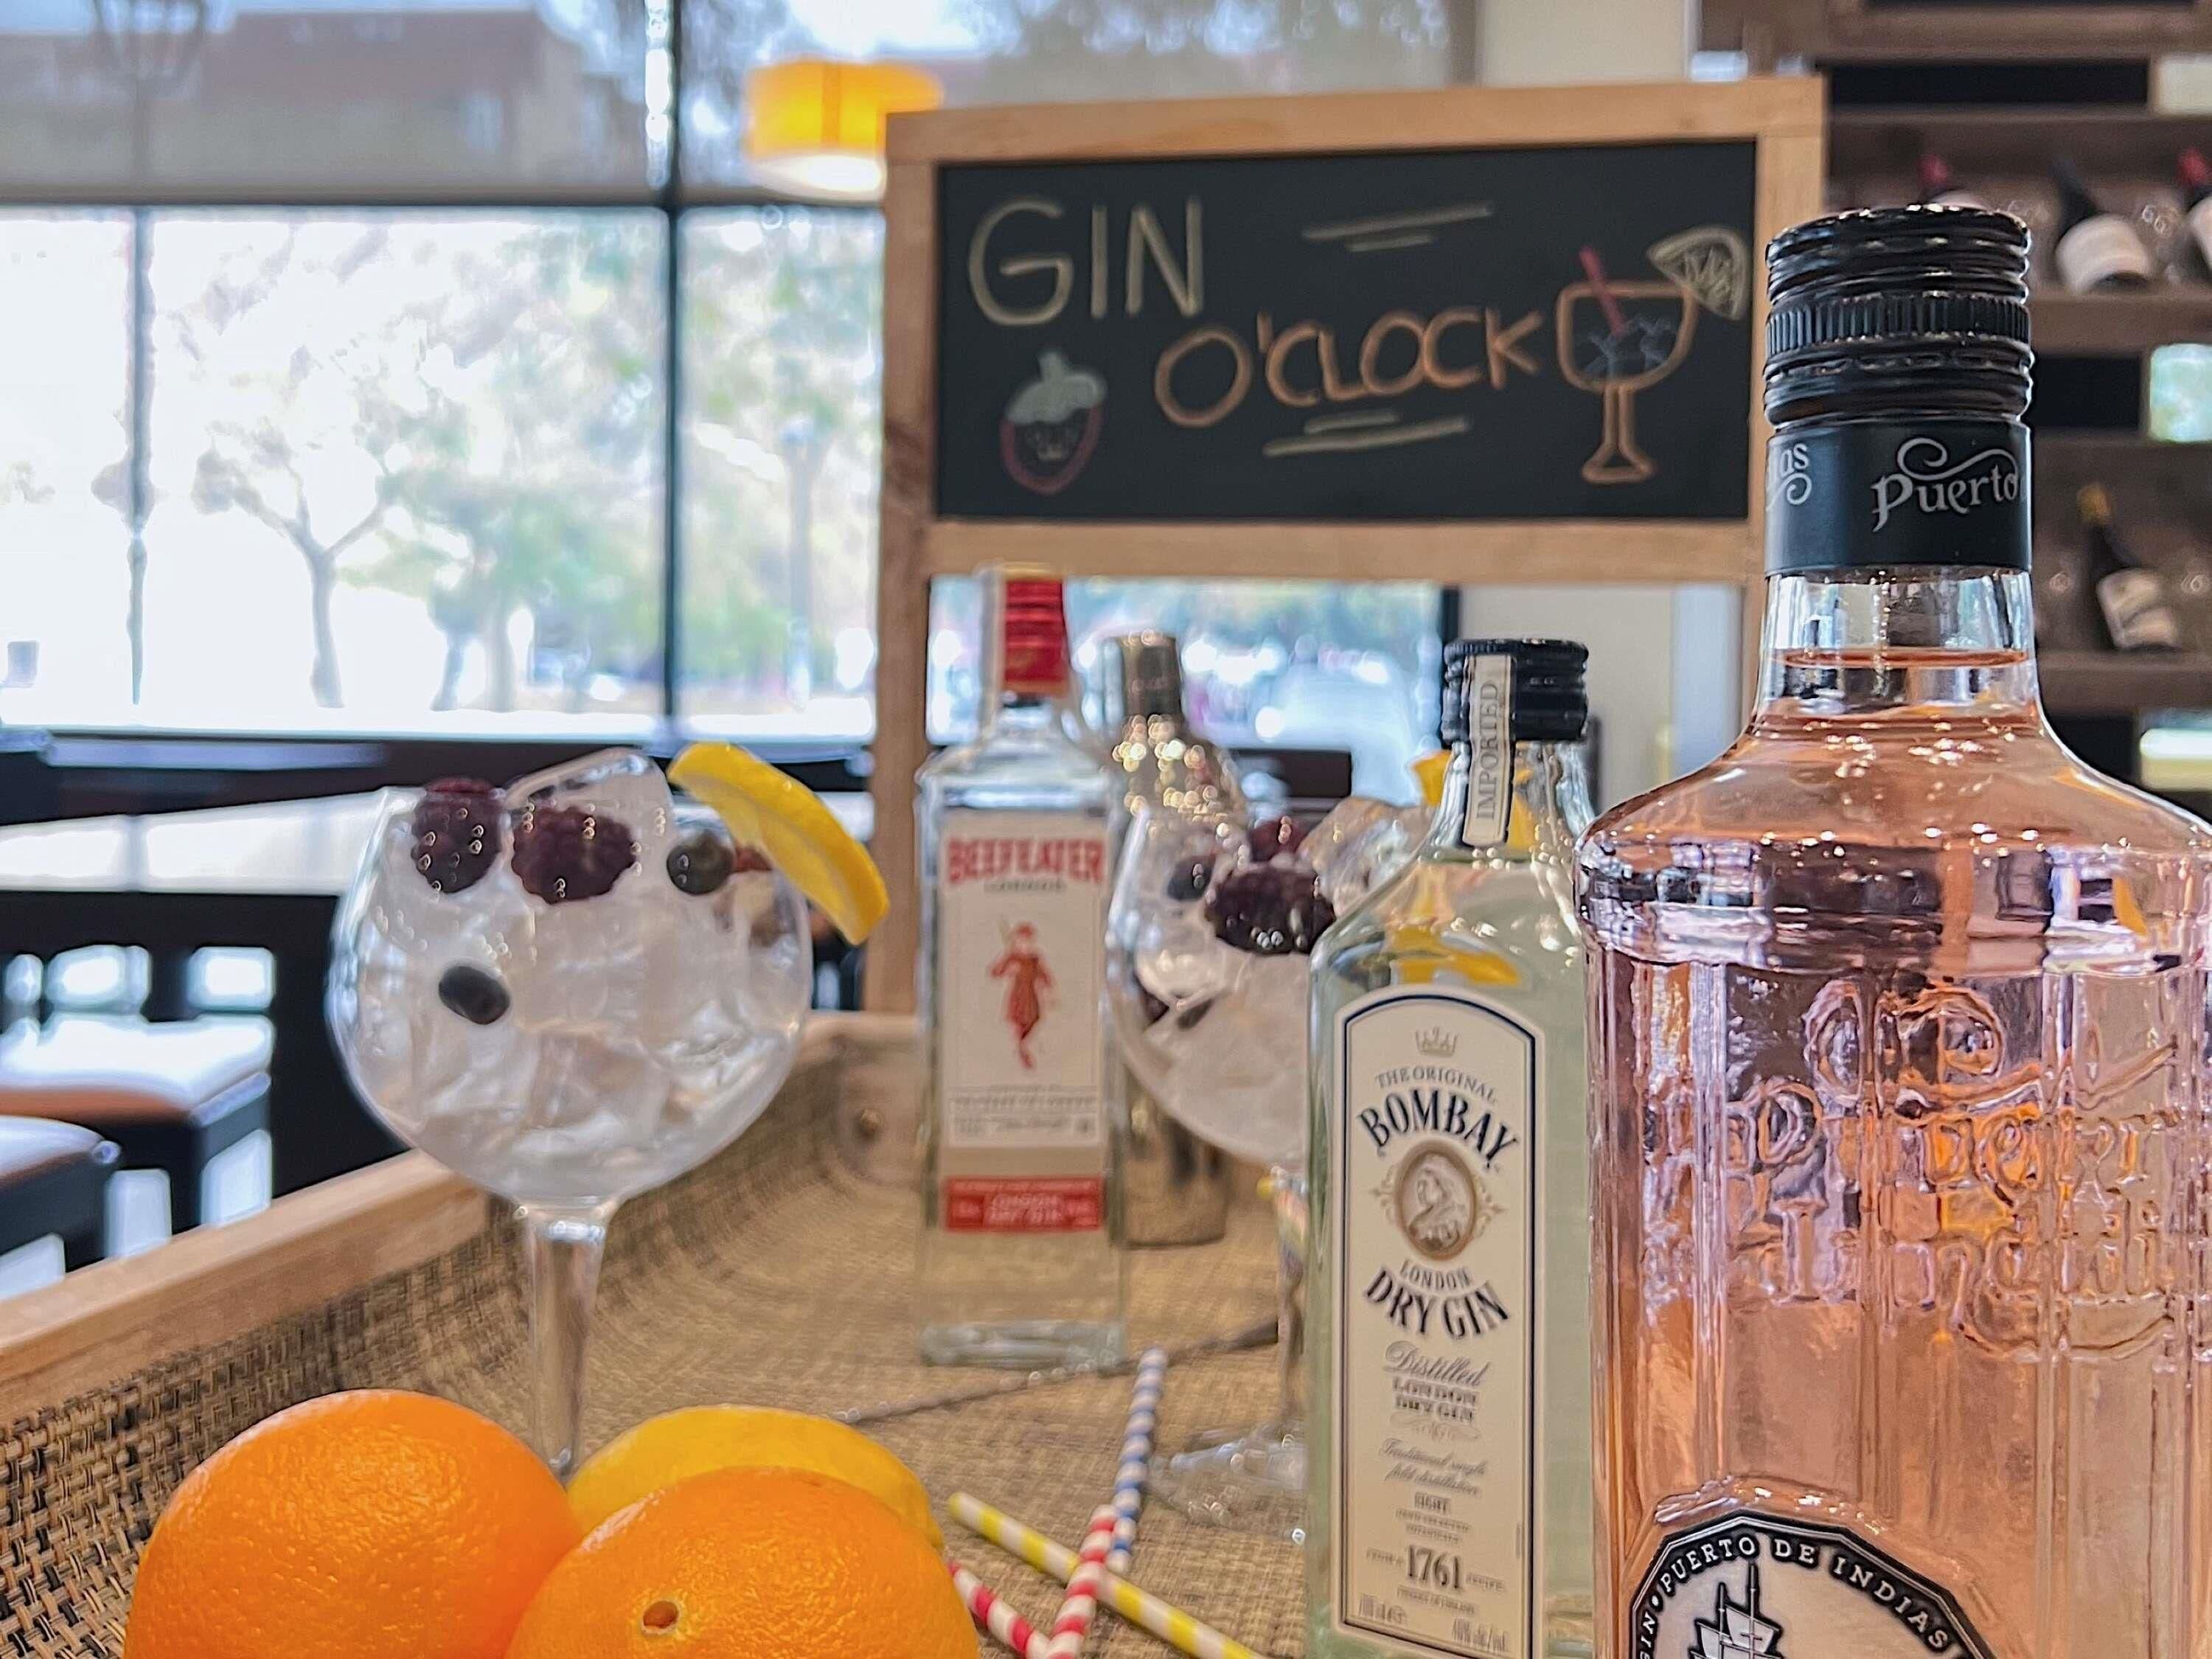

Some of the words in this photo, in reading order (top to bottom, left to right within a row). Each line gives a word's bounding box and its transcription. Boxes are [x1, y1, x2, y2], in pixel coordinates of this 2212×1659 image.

[968, 197, 1206, 326] GIN
[1871, 438, 2020, 532] Puerto
[1475, 681, 1500, 820] IMPORTED
[949, 837, 1105, 883] BEEFEATER
[1375, 1068, 1410, 1089] THE
[1412, 1065, 1497, 1104] ORIGINAL
[1359, 1088, 1518, 1162] BOMBAY
[1364, 1265, 1438, 1335] DRY
[1443, 1281, 1509, 1340] GIN
[1400, 1259, 1471, 1290] LONDON
[1382, 1340, 1492, 1387] Distilled
[1406, 1545, 1465, 1590] 1761
[1660, 1537, 1756, 1593] PUERTO
[1773, 1539, 1815, 1565] DE
[1833, 1557, 1949, 1649] INDIAS
